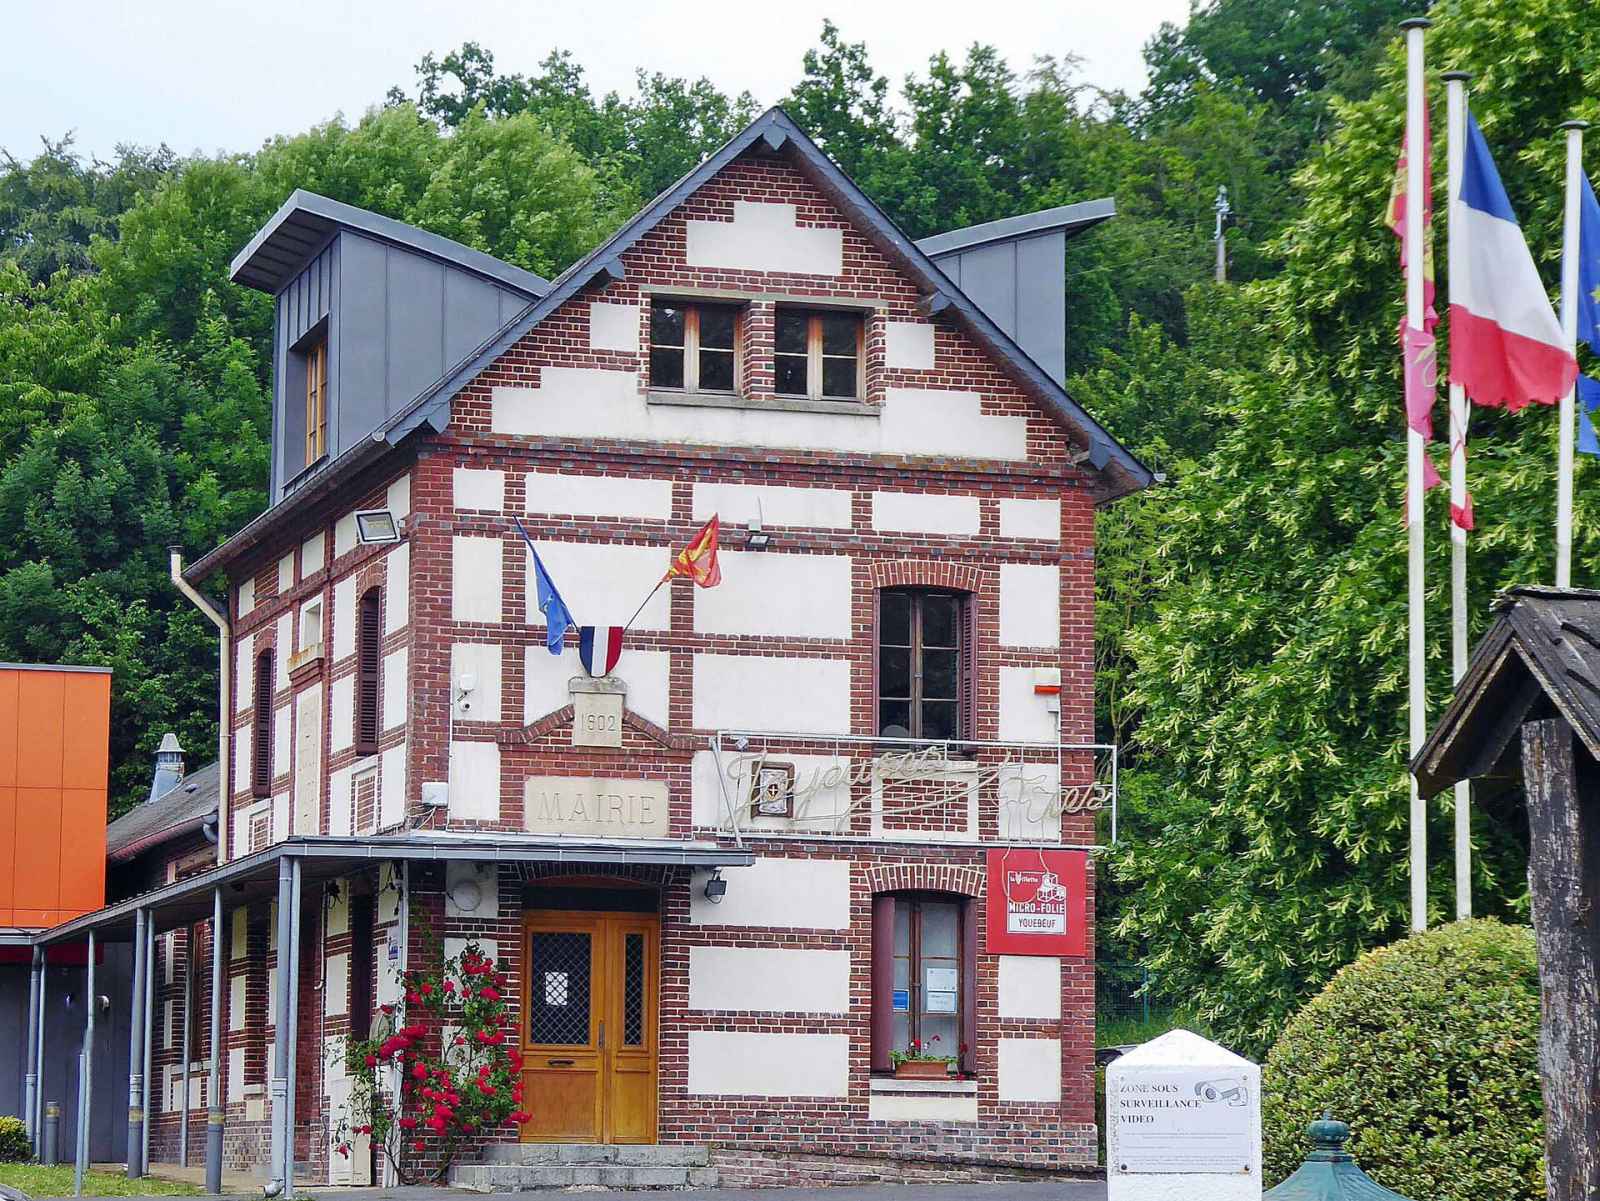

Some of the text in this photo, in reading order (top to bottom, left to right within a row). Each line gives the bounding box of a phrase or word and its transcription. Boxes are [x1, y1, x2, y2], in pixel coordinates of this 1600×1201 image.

[579, 712, 616, 732] 1902
[537, 791, 656, 825] MAIRIE
[1008, 903, 1065, 914] MICRO-FOLIE
[1120, 1084, 1178, 1093] ZONE SOUS
[1120, 1099, 1202, 1109] SURVEILLANCE
[1120, 1115, 1155, 1124] VIDEO
